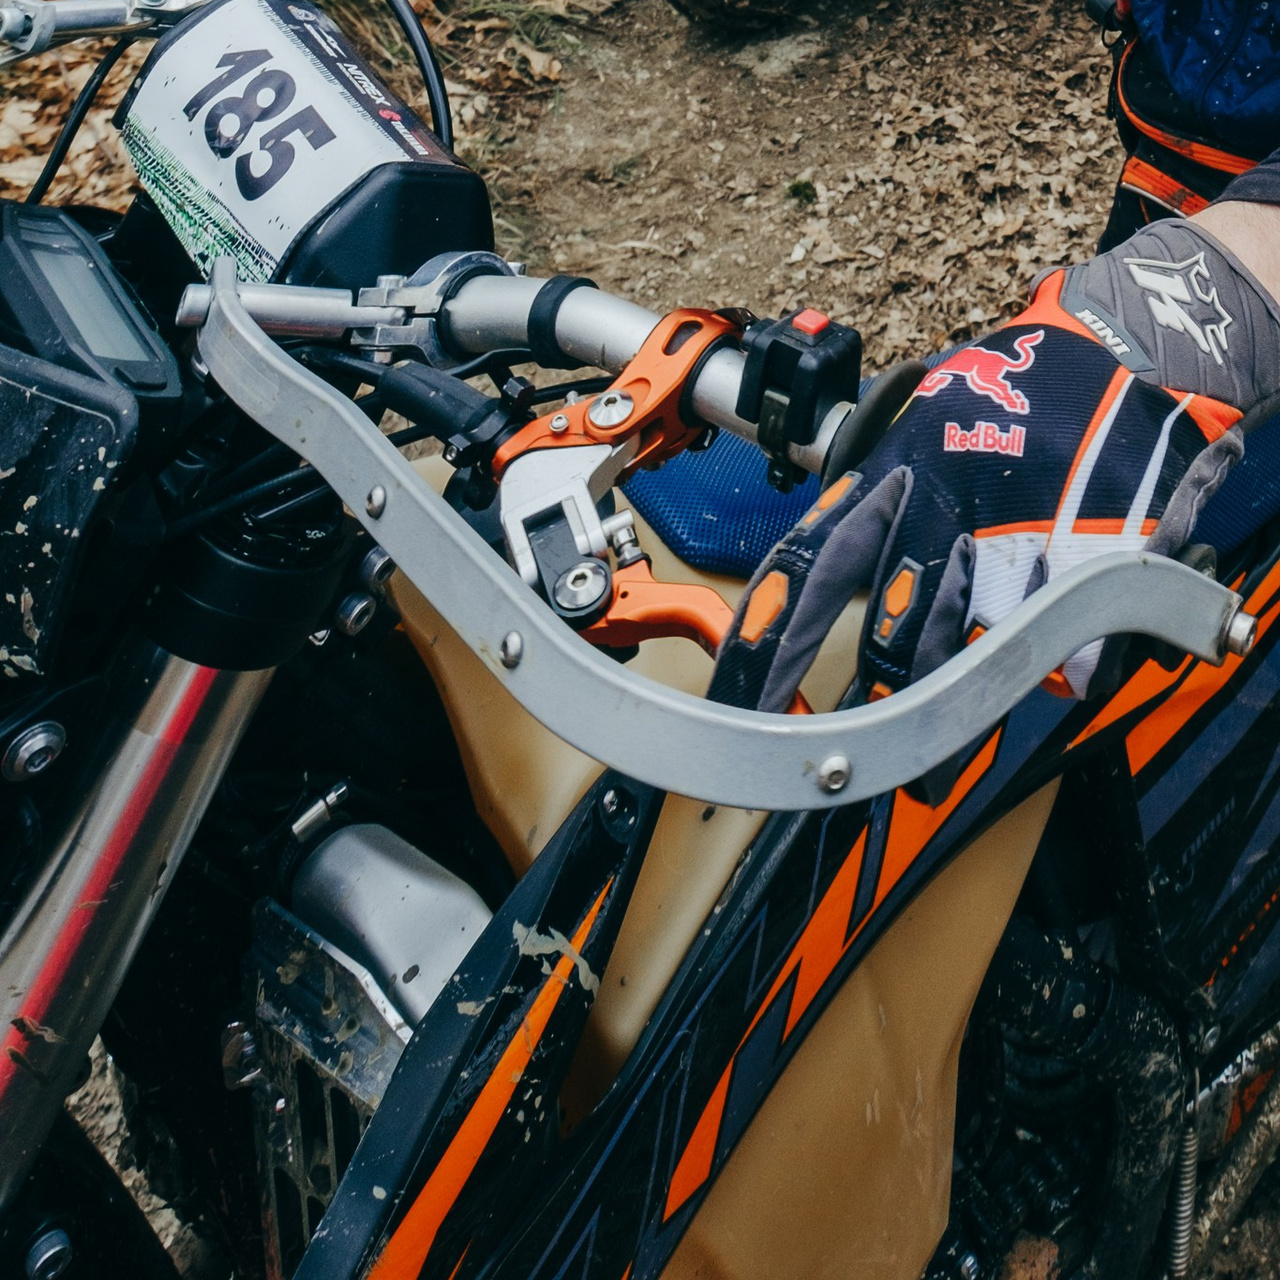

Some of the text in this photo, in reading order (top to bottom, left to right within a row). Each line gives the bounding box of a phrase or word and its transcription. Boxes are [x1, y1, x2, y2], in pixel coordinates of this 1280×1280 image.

[182, 48, 337, 202] 185
[1075, 308, 1132, 356] KINI
[944, 421, 1027, 458] Red Bull
